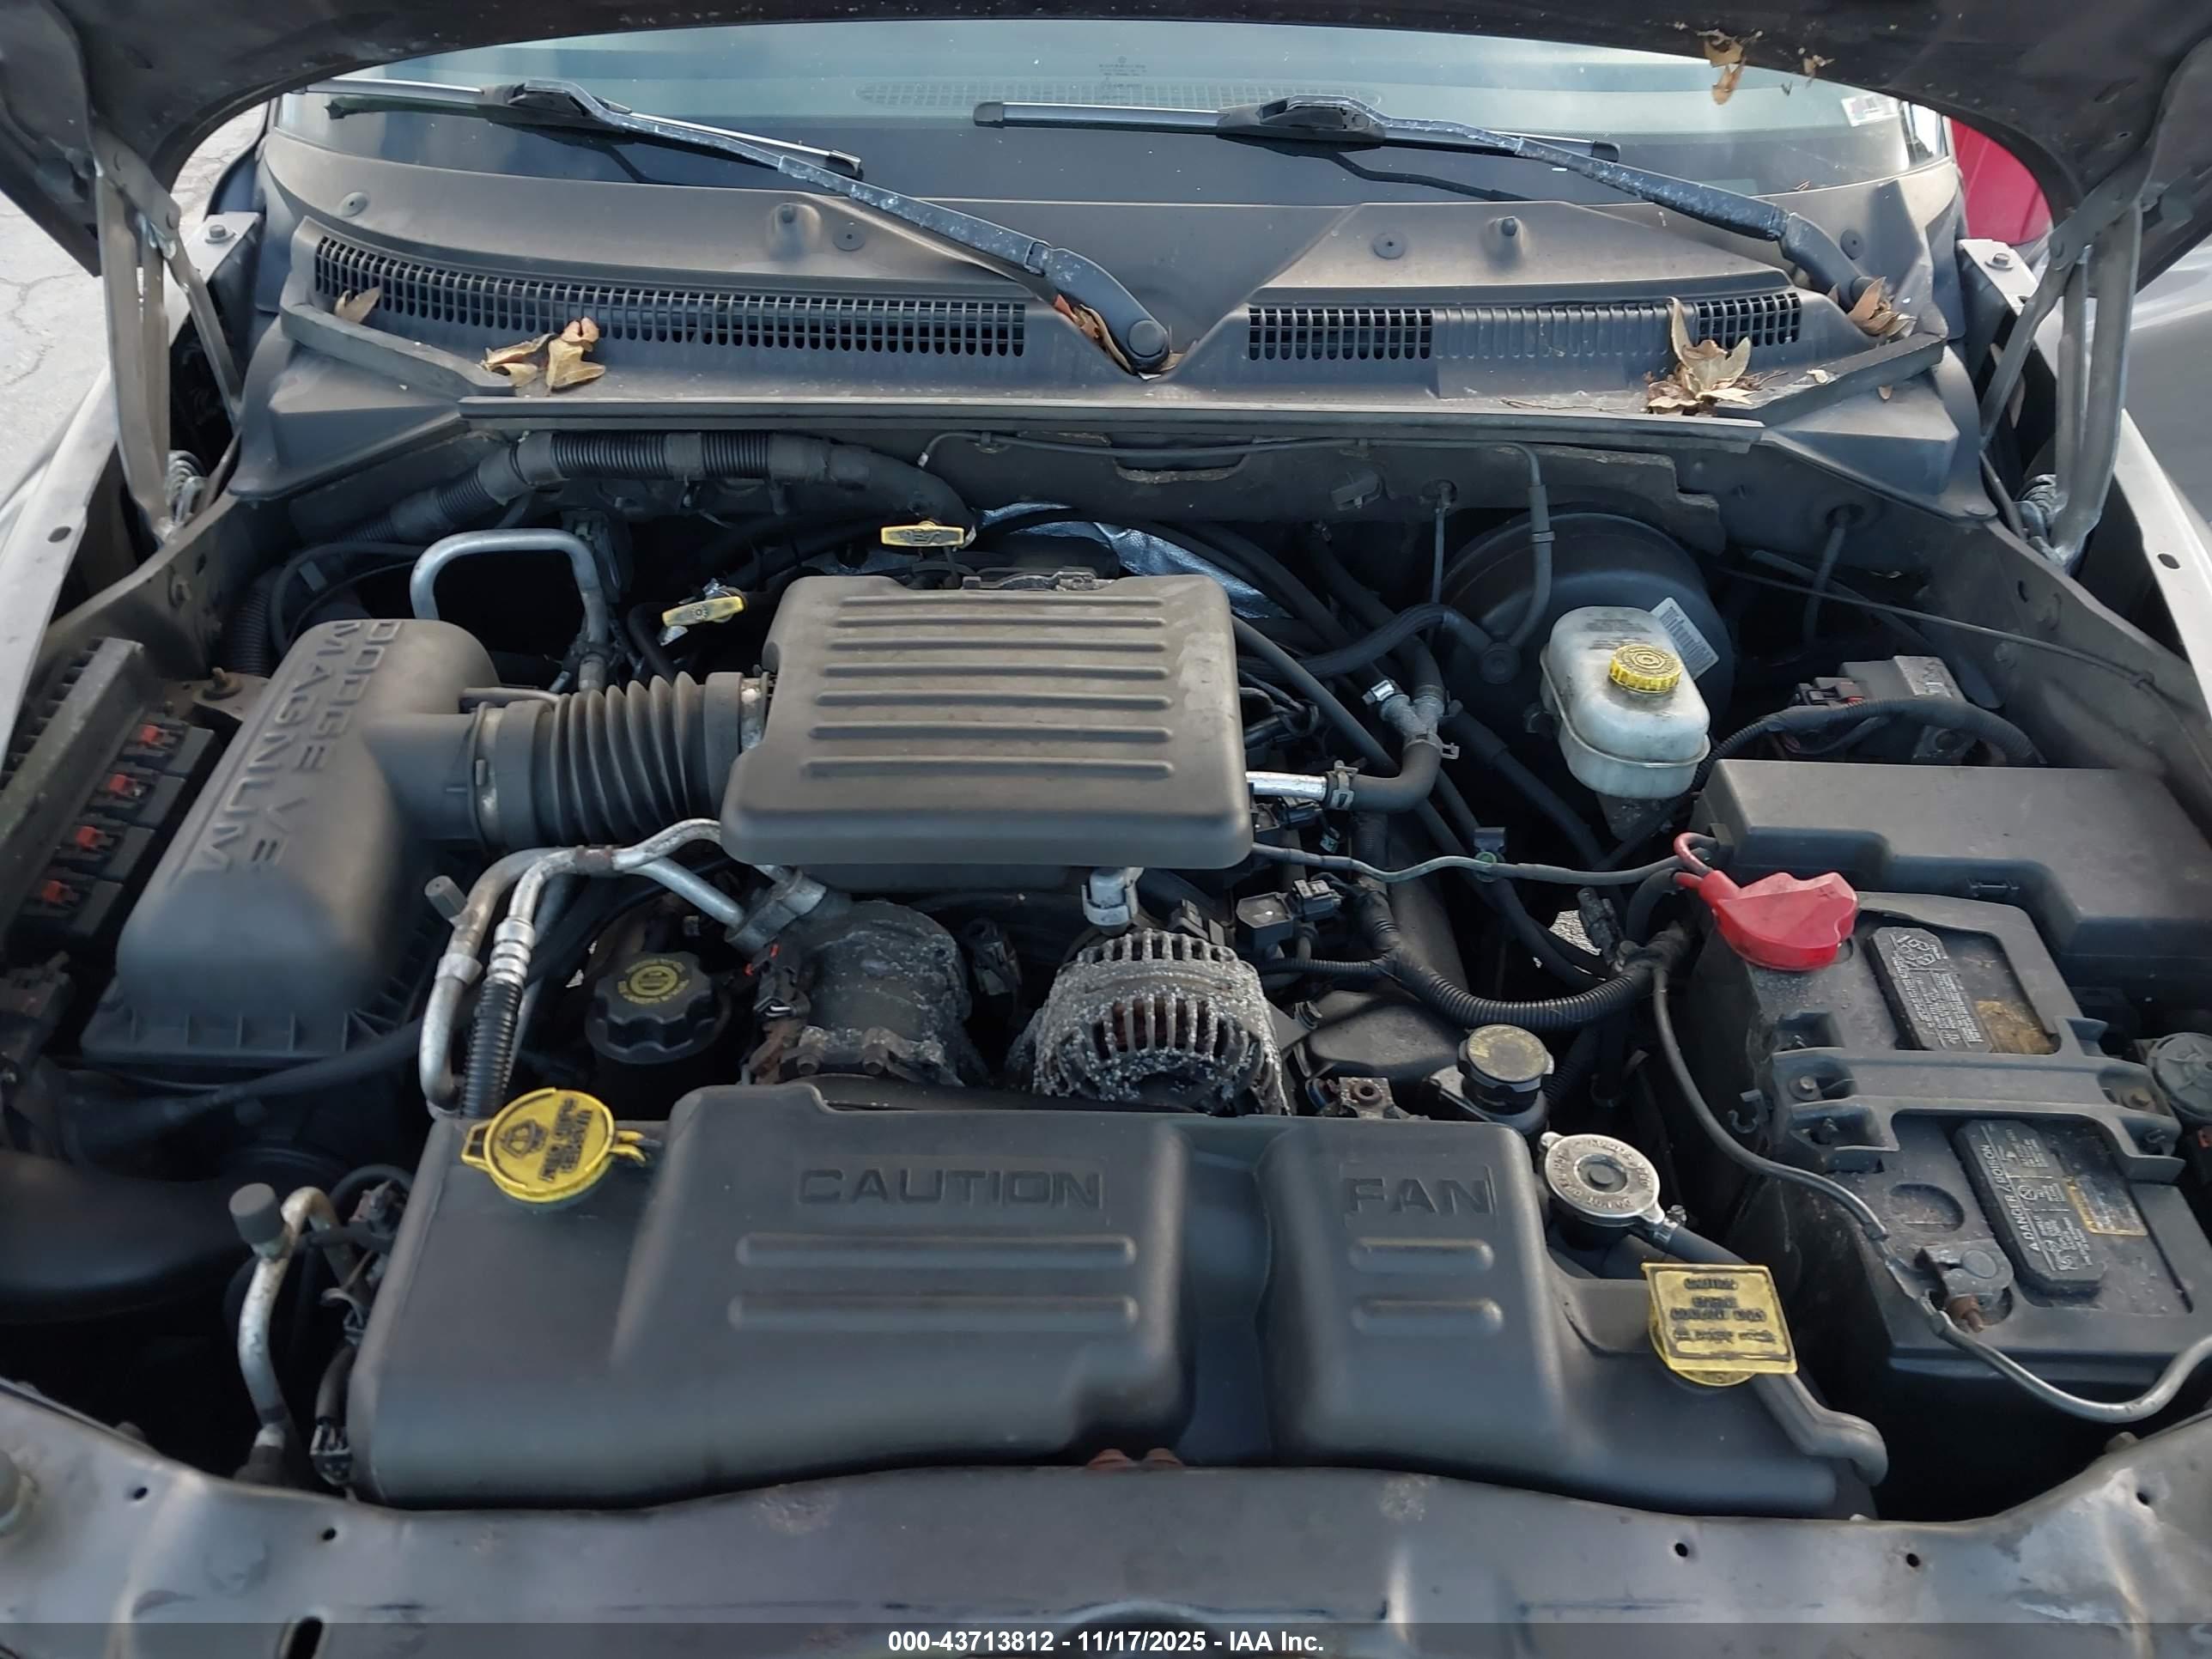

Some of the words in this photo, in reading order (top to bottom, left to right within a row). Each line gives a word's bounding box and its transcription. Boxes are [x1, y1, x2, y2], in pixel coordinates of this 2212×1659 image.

[294, 621, 402, 771] DODGE
[201, 621, 363, 872] MAGNUM
[1980, 1144, 2007, 1186] POISON
[798, 1168, 1103, 1209] CAUTION
[1344, 1176, 1493, 1215] FAN
[2004, 1194, 2036, 1241] DANGER
